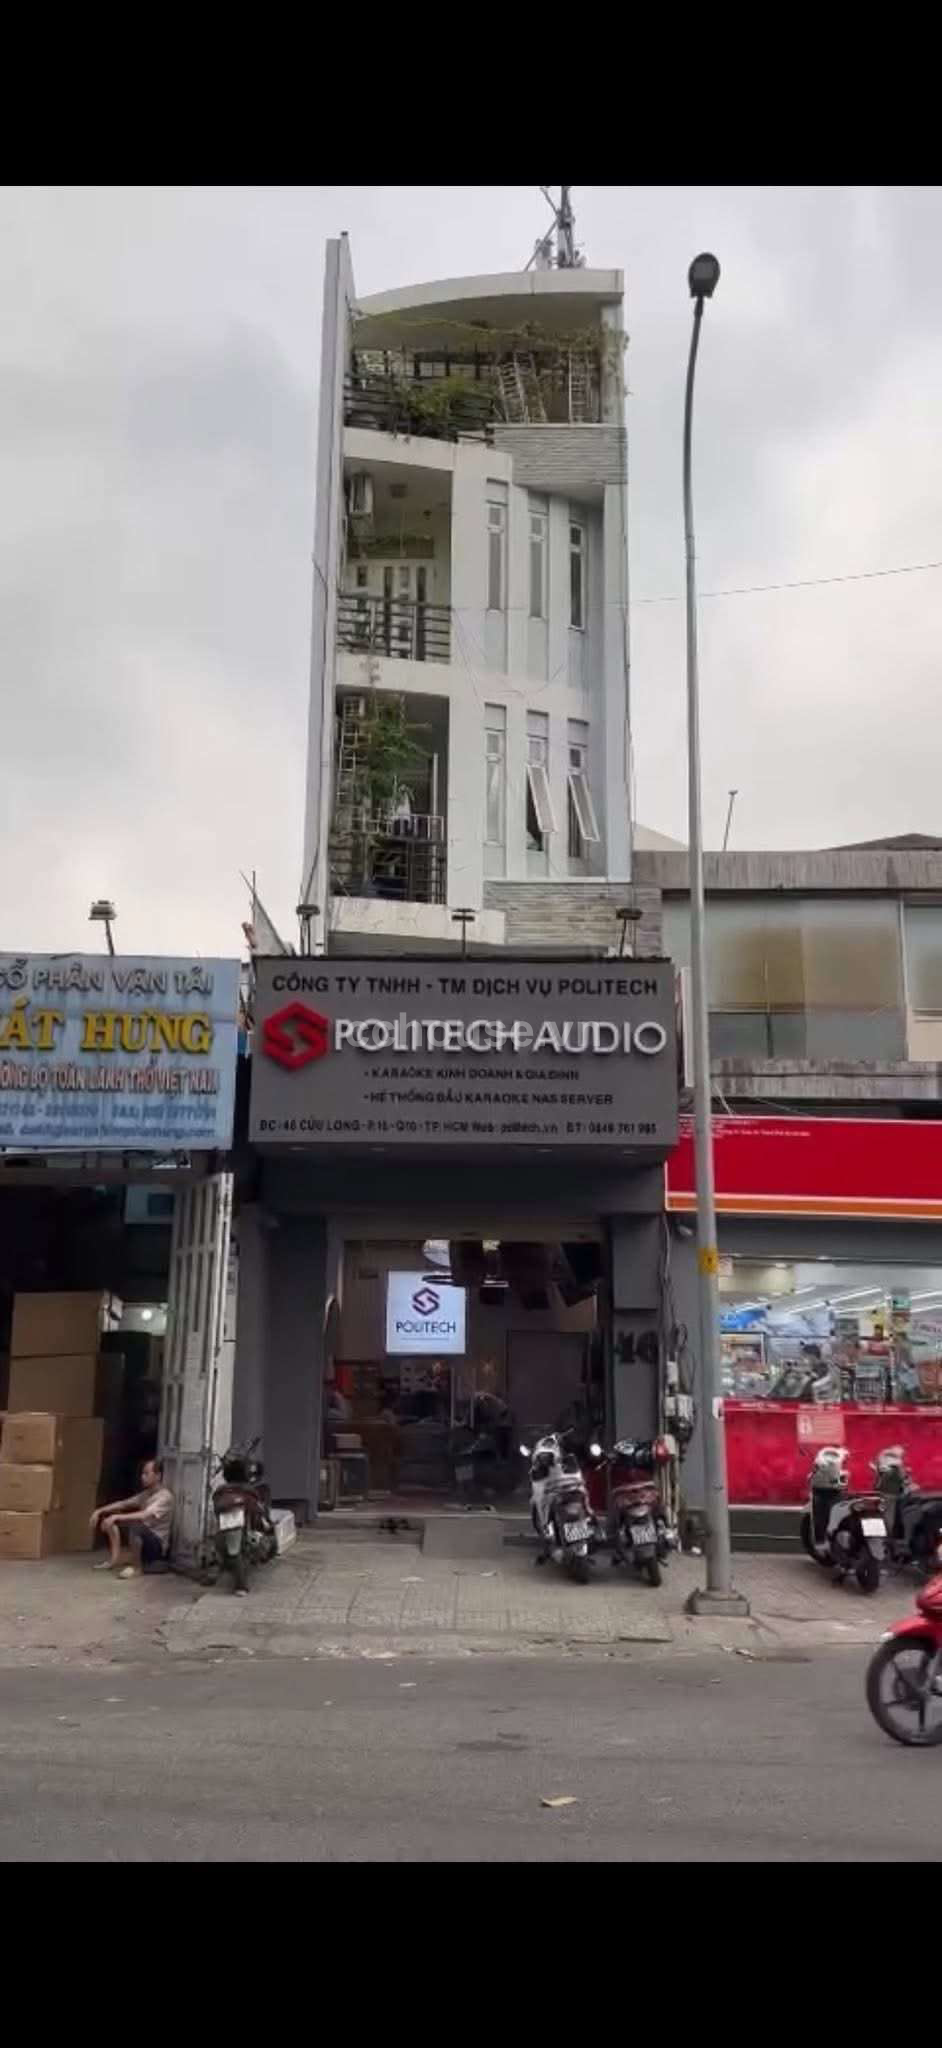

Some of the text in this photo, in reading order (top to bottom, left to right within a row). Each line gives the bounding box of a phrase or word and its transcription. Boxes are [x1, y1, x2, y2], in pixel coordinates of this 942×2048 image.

[0, 958, 29, 991] Ổ
[272, 971, 329, 992] CÔNG
[335, 976, 361, 993] TY
[367, 976, 420, 994] TNHH
[438, 977, 467, 994] TM
[473, 977, 520, 998] DỊCH
[526, 978, 553, 998] VỤ
[558, 977, 657, 996] POLITECH
[79, 1008, 213, 1054] HƯNG
[335, 1018, 668, 1054] POLITECH AUDIO
[436, 1068, 465, 1079] KINH
[468, 1068, 513, 1080] DOANH
[464, 1093, 529, 1104] KARAOKE
[532, 1093, 558, 1105] NAS
[560, 1093, 614, 1106] SERVER
[395, 1320, 456, 1334] POLITECH
